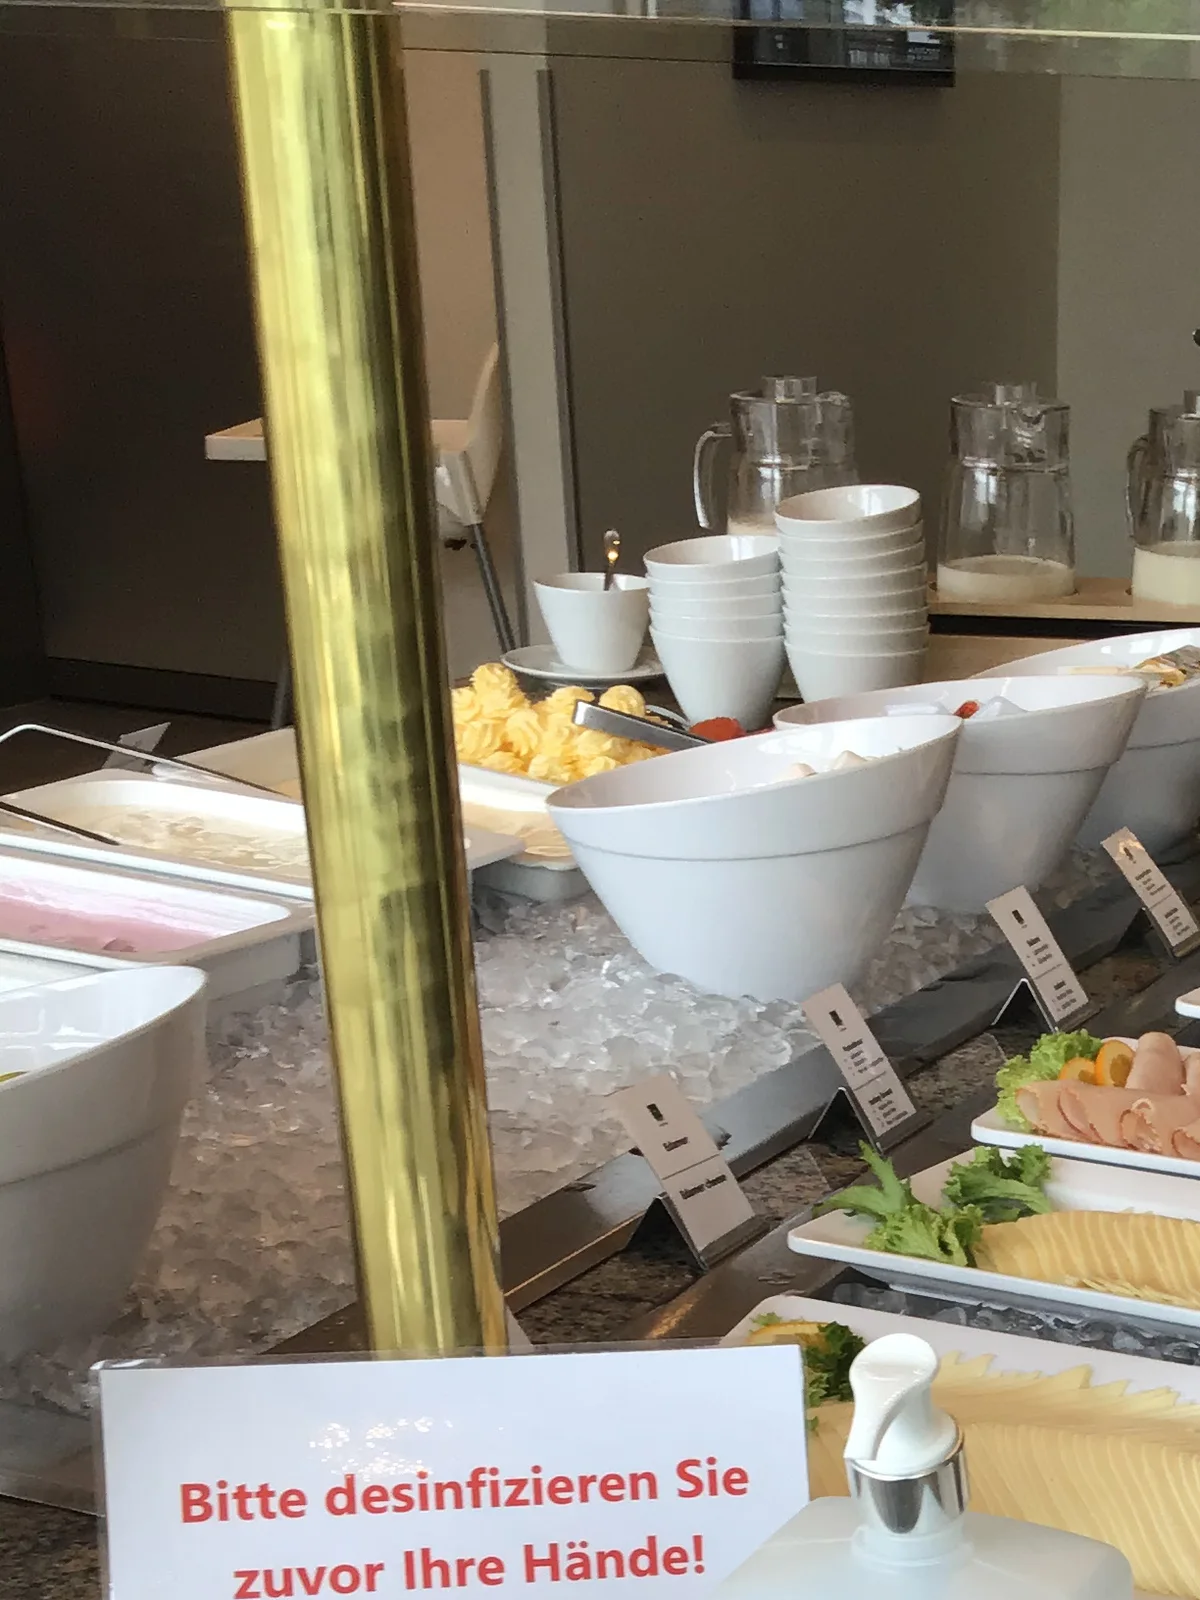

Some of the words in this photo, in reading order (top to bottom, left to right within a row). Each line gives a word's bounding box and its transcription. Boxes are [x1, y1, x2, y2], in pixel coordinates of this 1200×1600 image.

[181, 1478, 307, 1523] Bitte
[325, 1464, 658, 1517] desinfizieren
[676, 1456, 749, 1499] Sie
[234, 1562, 385, 1600] zuvor
[404, 1547, 505, 1590] Ihre
[523, 1534, 704, 1583] Hände!
